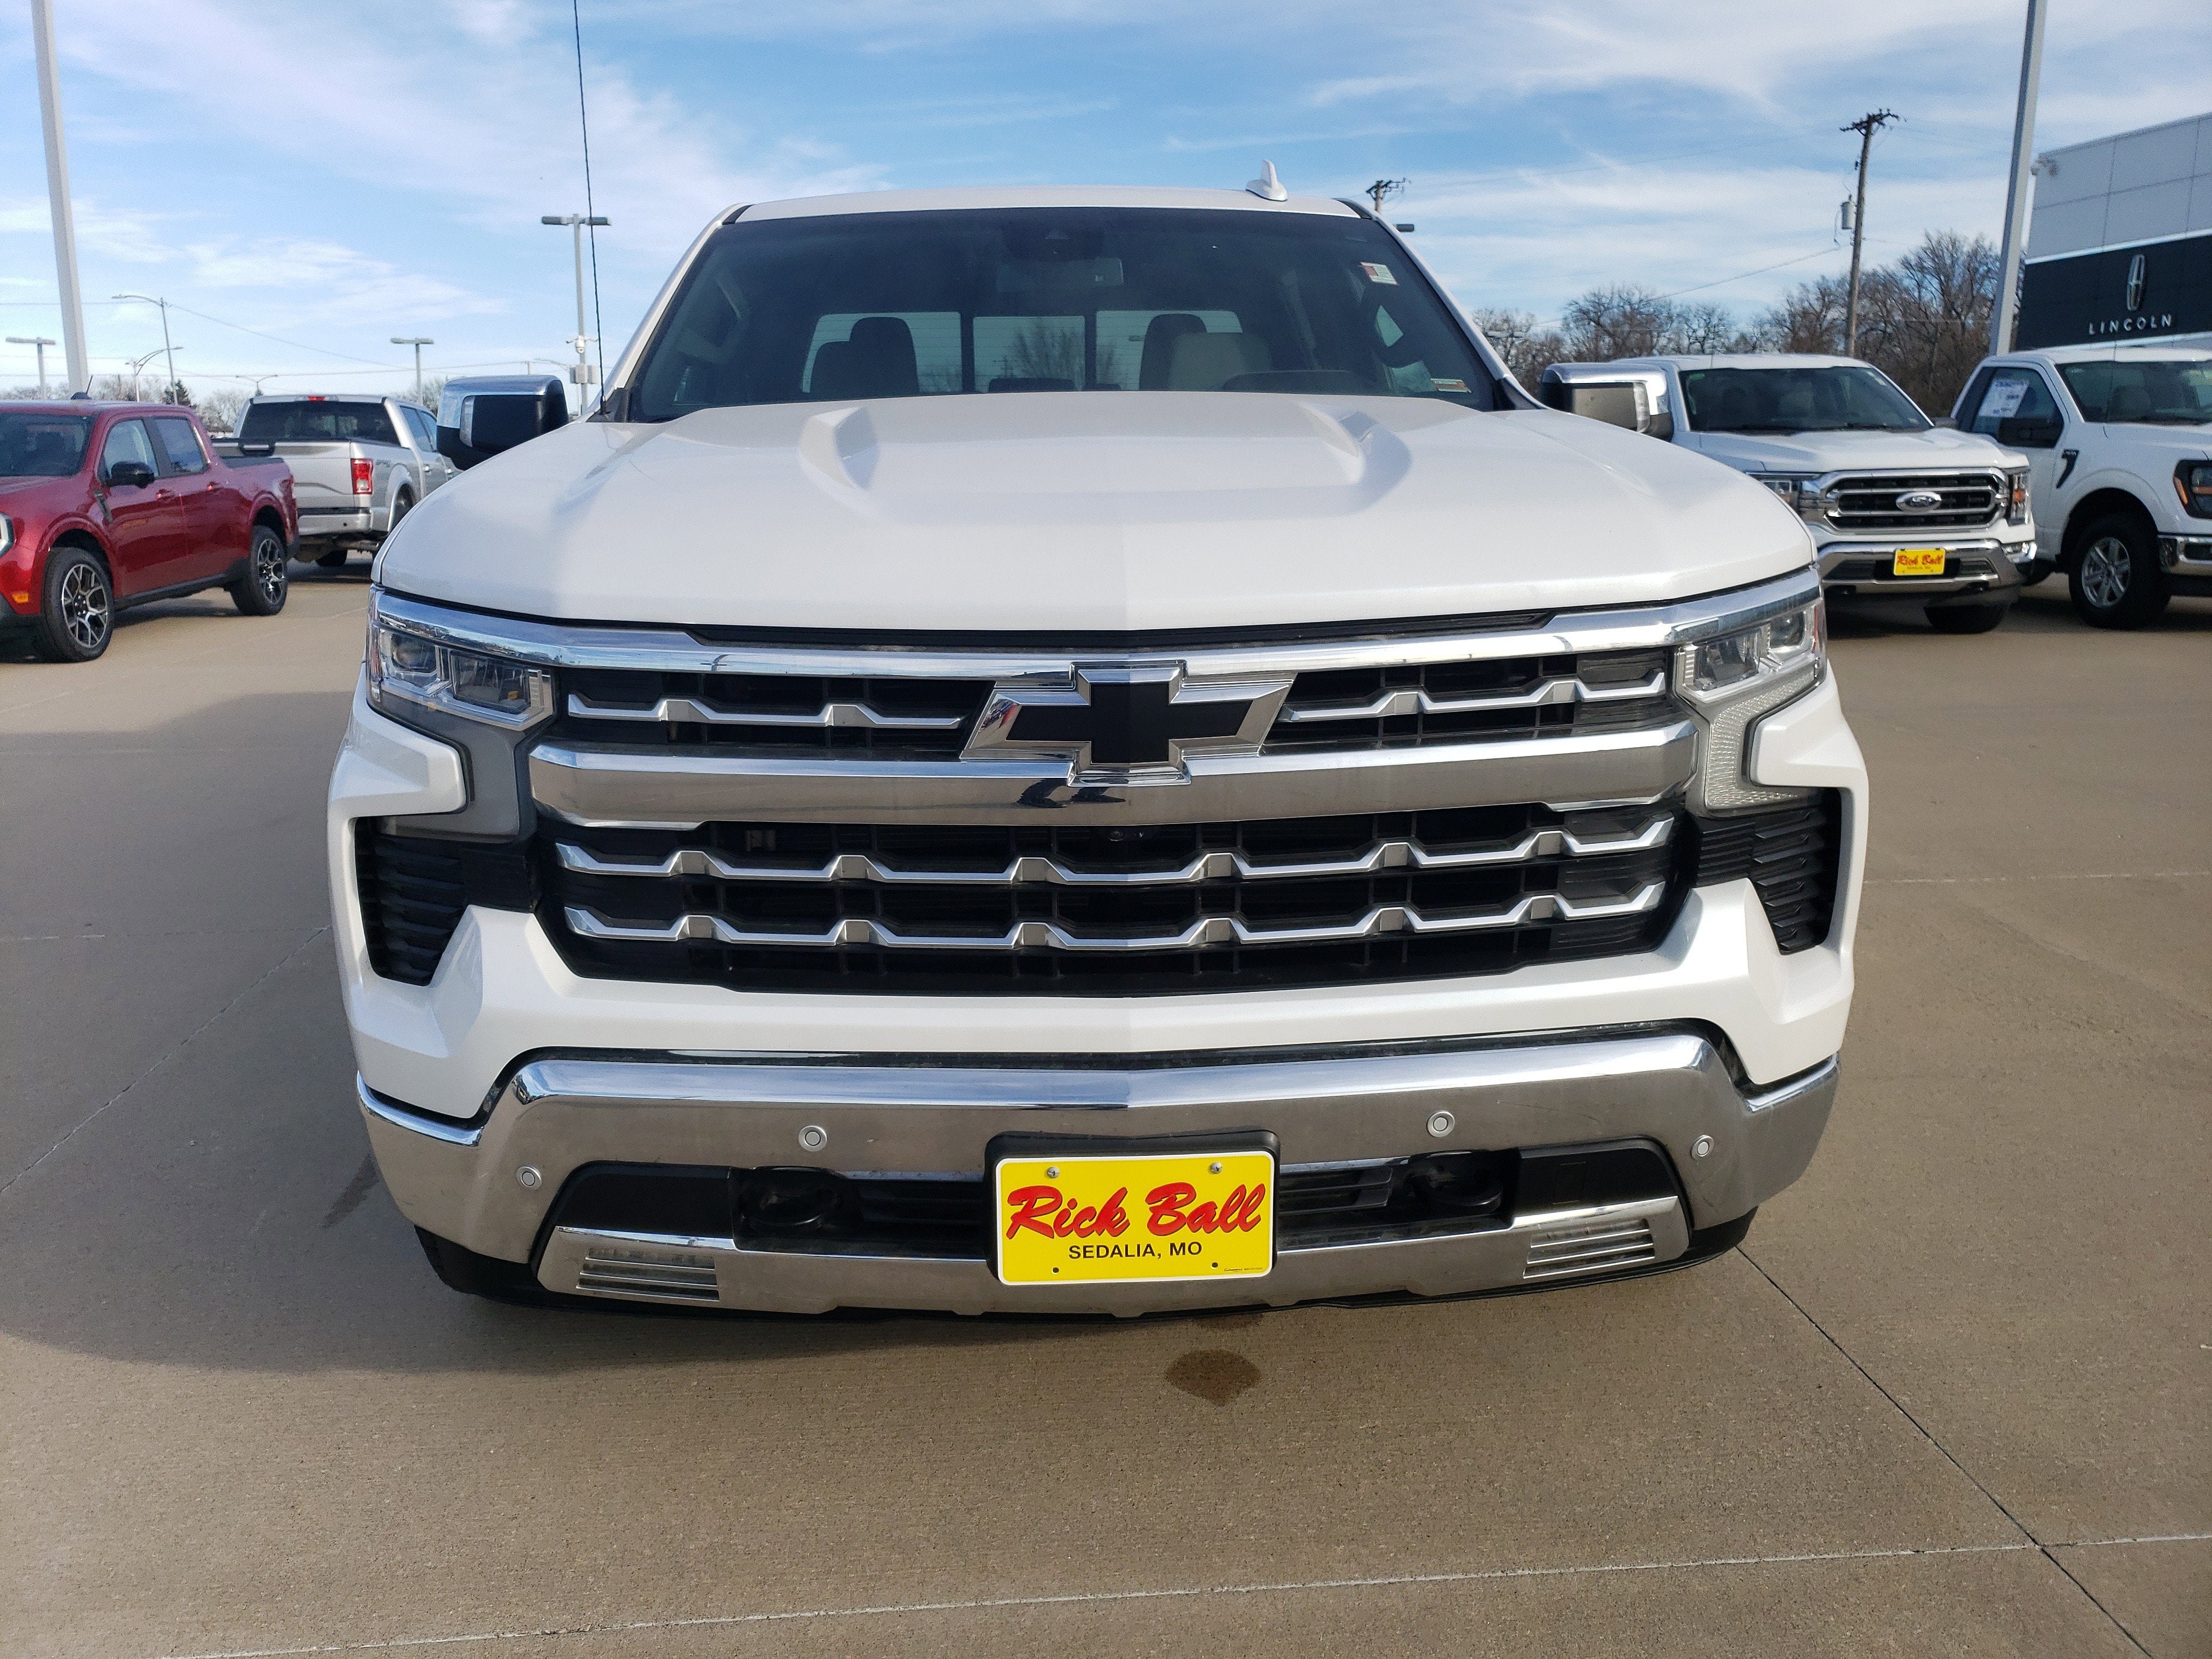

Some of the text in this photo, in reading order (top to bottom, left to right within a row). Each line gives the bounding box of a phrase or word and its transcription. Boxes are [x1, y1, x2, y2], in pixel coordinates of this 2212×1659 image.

[2087, 314, 2172, 335] LINCOLN
[1006, 1182, 1266, 1240] Rick Ball
[1068, 1241, 1203, 1260] SEDALIA, MO
